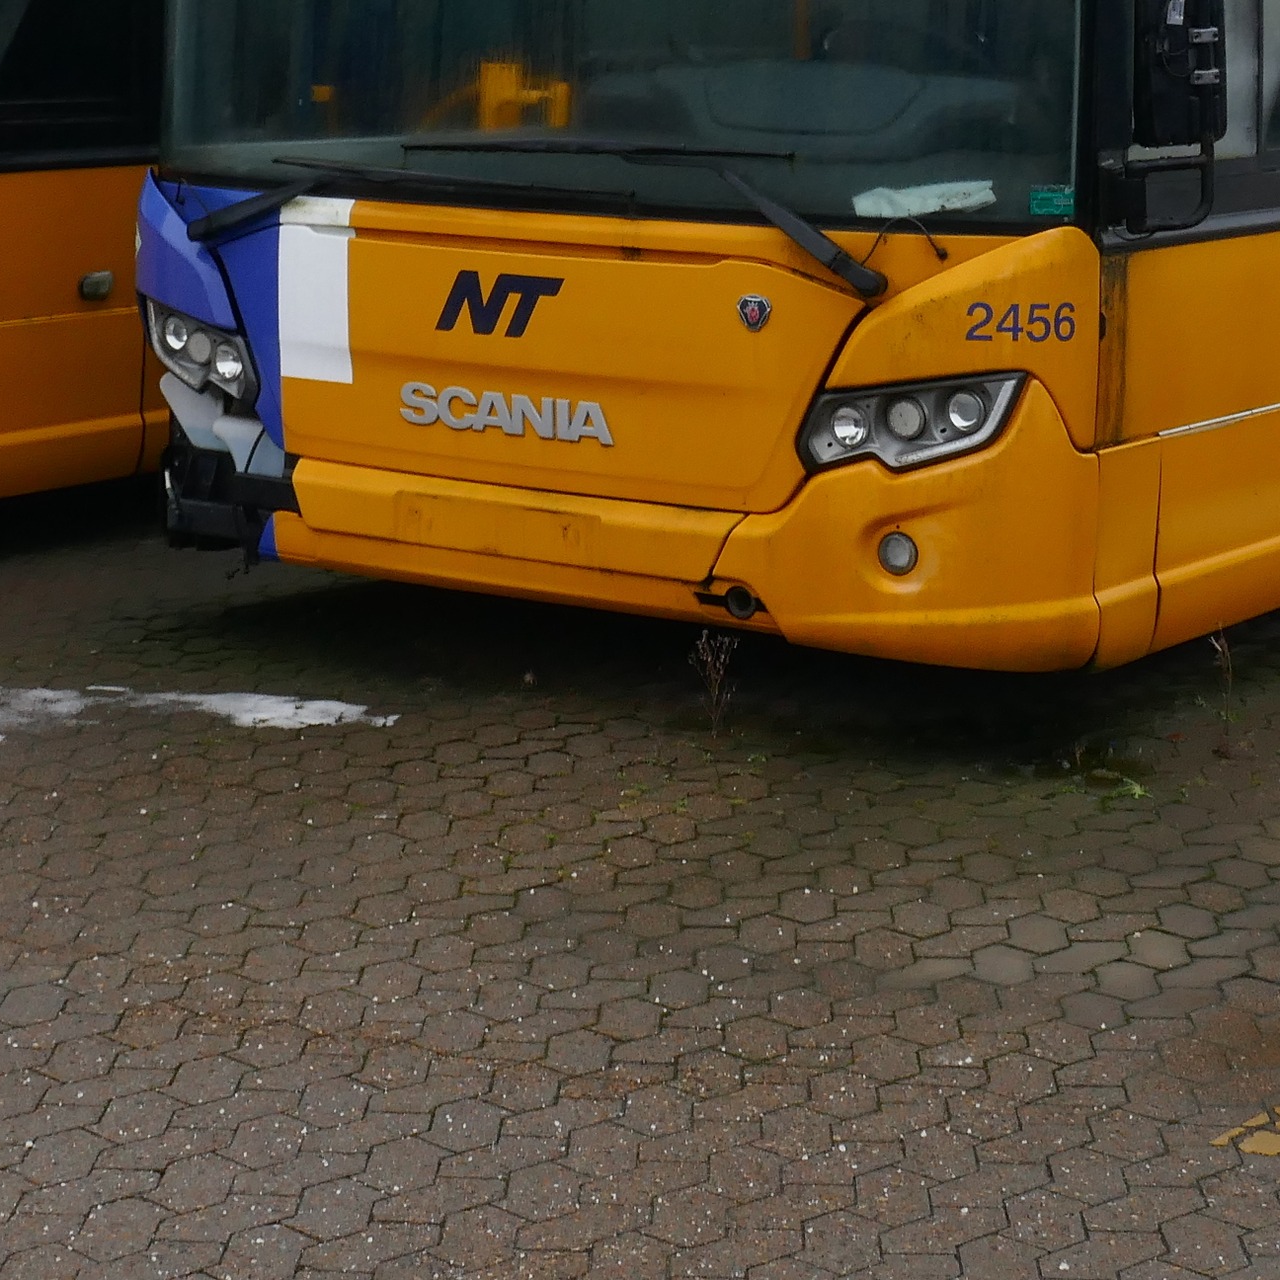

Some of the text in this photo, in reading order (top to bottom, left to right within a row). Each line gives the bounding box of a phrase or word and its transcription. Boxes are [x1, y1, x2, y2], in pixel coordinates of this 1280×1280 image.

[433, 269, 565, 338] NT
[964, 301, 1076, 343] 2456
[399, 382, 616, 447] SCANIA
